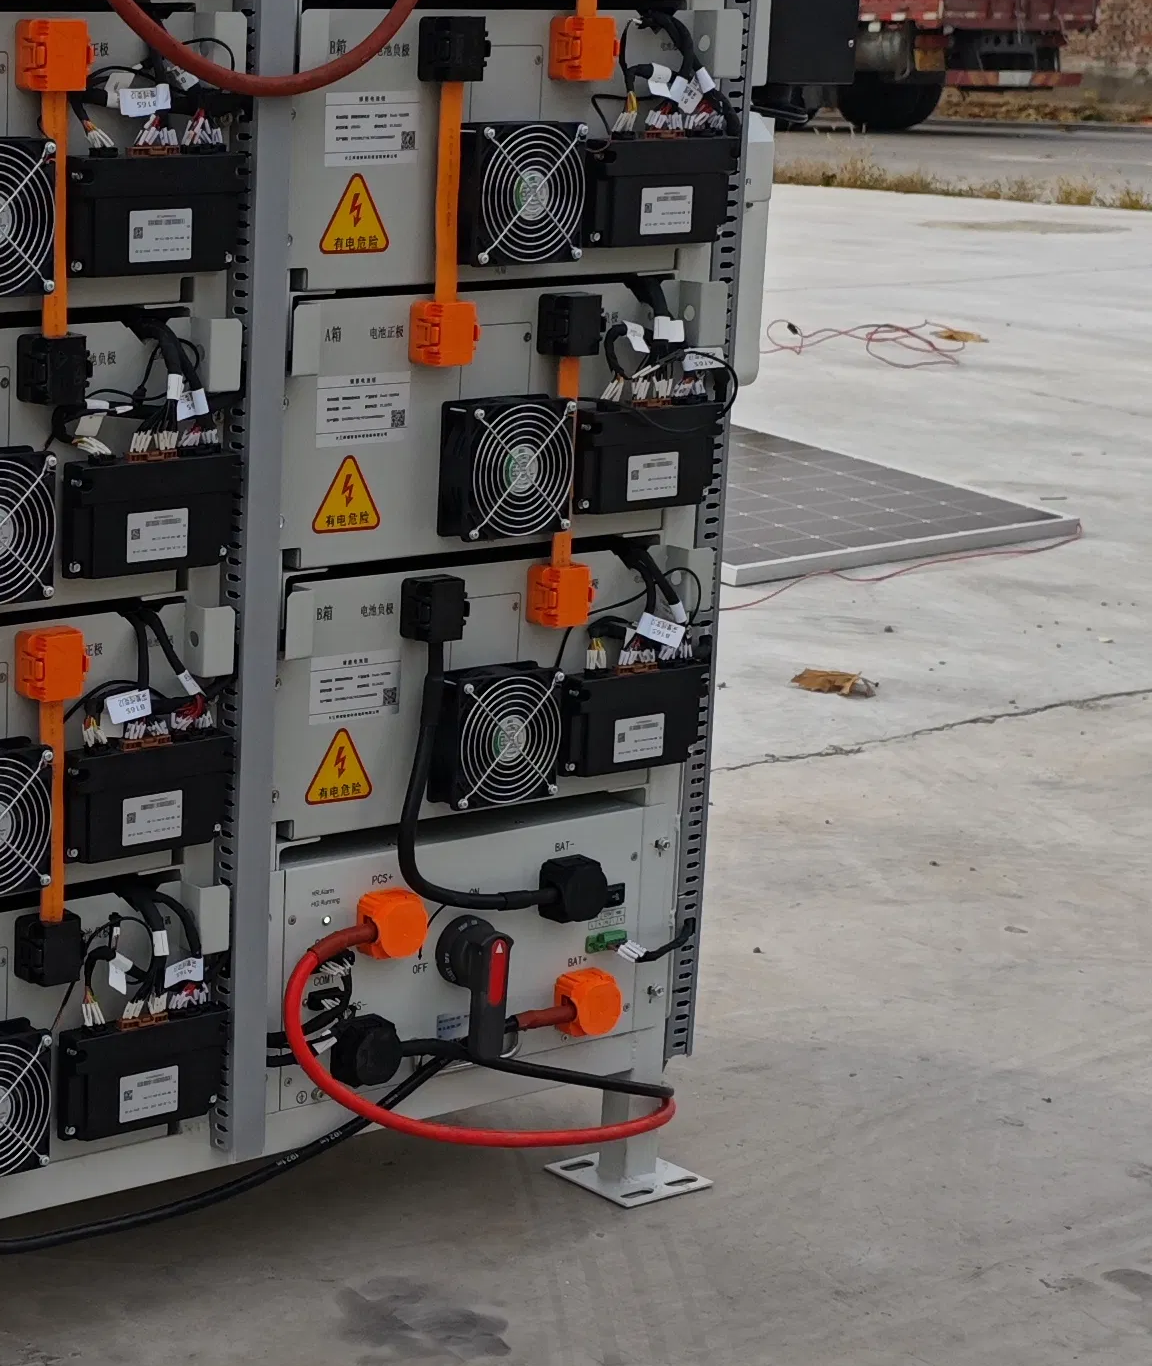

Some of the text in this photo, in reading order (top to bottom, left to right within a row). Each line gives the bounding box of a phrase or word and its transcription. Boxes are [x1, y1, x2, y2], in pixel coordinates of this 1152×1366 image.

[330, 39, 347, 56] B箱
[334, 235, 379, 250] 有电危险
[325, 326, 341, 343] A箱
[370, 324, 404, 339] 电池正极
[326, 511, 370, 527] 有电危险
[316, 605, 333, 621] B箱
[361, 602, 394, 618] 电池负极
[318, 782, 362, 799] 有电危险
[554, 841, 574, 852] BAT-
[371, 873, 394, 885] PCS+
[412, 962, 428, 974] OFF
[568, 956, 588, 967] BAT+
